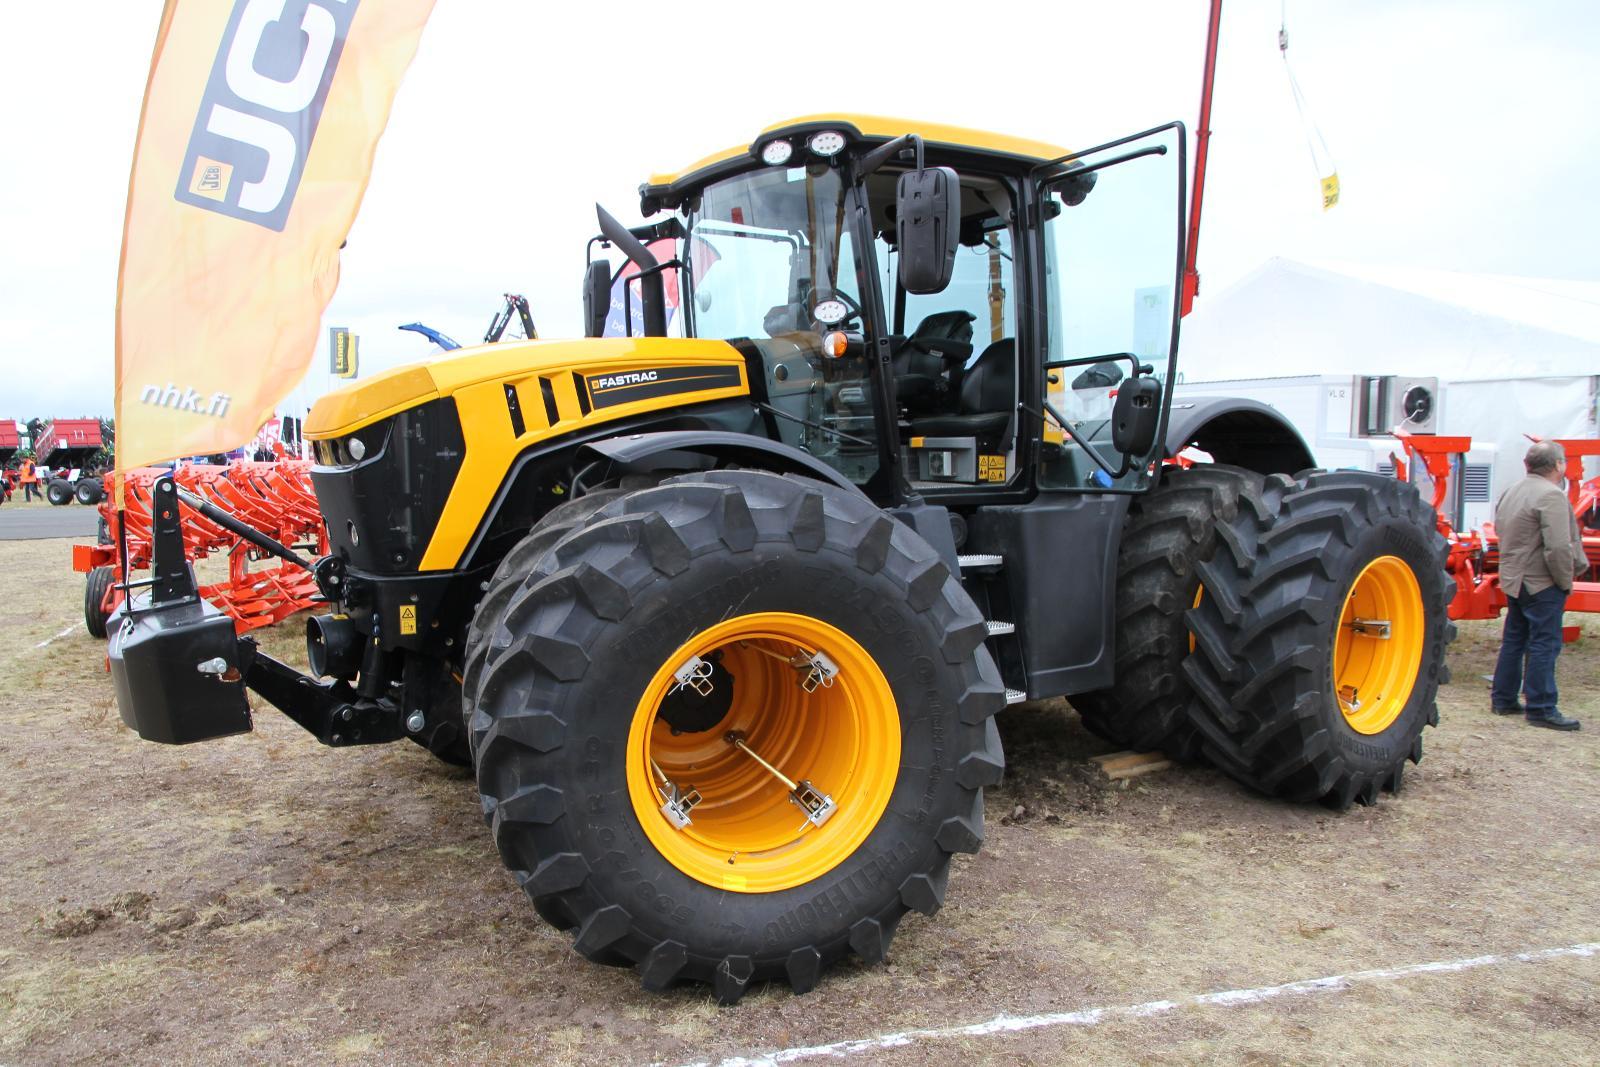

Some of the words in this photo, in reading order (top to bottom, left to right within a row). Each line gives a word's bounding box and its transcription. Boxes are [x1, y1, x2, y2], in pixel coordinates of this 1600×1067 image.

[205, 0, 348, 213] JC
[201, 167, 219, 188] JCB
[599, 371, 657, 388] FASTRAC
[140, 382, 231, 416] nhk.fi
[764, 840, 918, 946] TRELLEBORG
